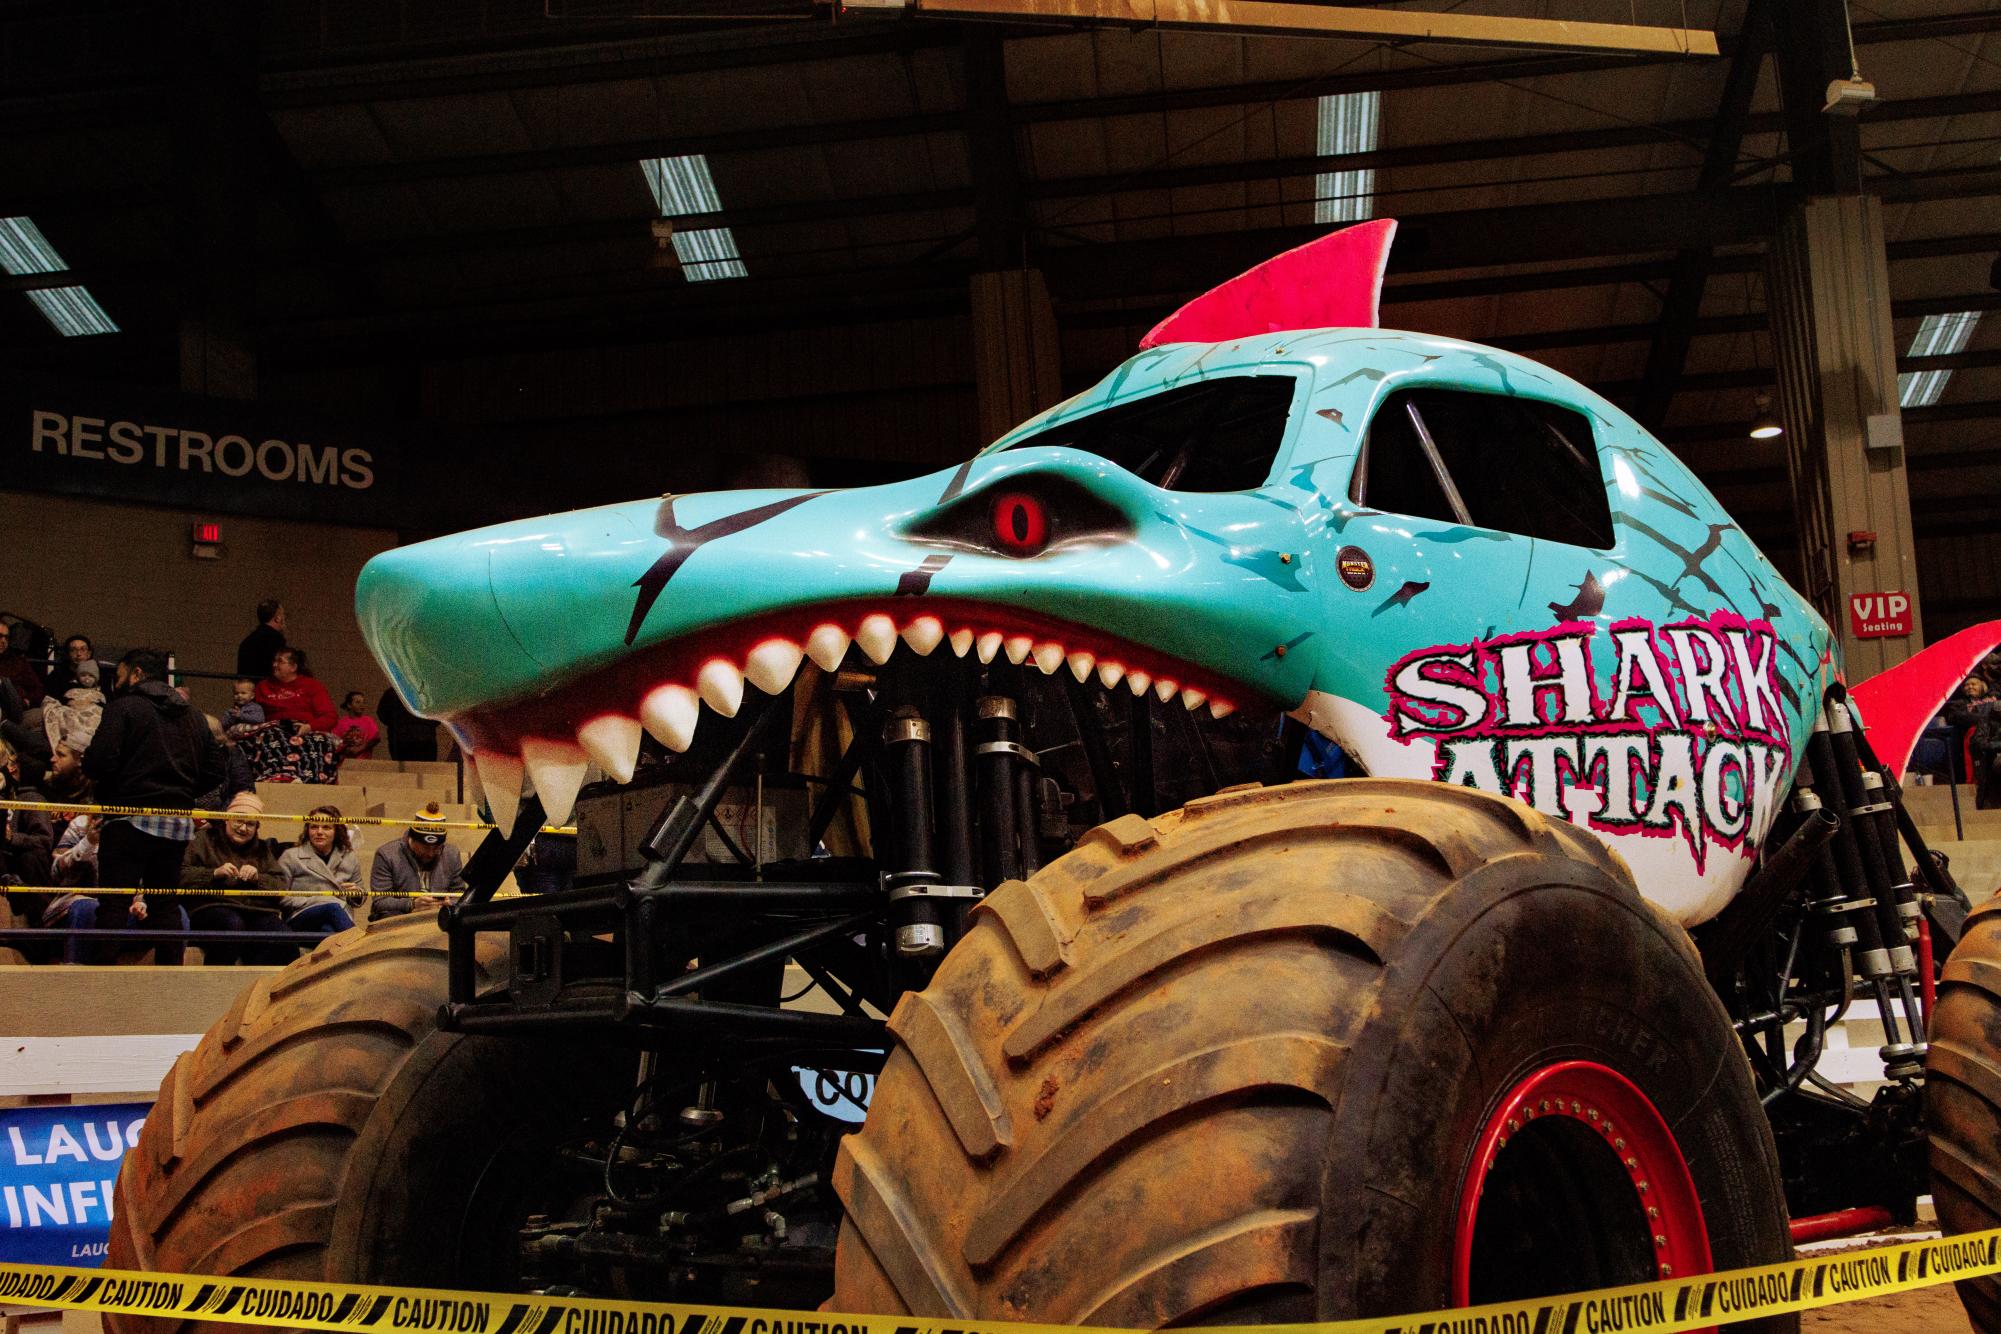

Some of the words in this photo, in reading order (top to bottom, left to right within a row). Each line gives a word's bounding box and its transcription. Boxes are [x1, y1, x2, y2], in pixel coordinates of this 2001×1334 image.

[32, 410, 374, 488] RESTROOMS
[1853, 595, 1907, 620] VIP
[1863, 622, 1902, 632] Seating
[1388, 618, 1791, 742] SHARK
[1440, 731, 1786, 862] ATTACK
[98, 1278, 184, 1310] CAUTION
[241, 1287, 334, 1322] CUIDADO
[392, 1297, 490, 1334] CAUTION
[565, 1308, 675, 1334] CUIDADO
[1586, 1291, 1667, 1334] CAUTION
[1718, 1271, 1789, 1313] CUIDADO
[1829, 1255, 1892, 1293] CAUTION
[1930, 1238, 1988, 1275] CUIDADO
